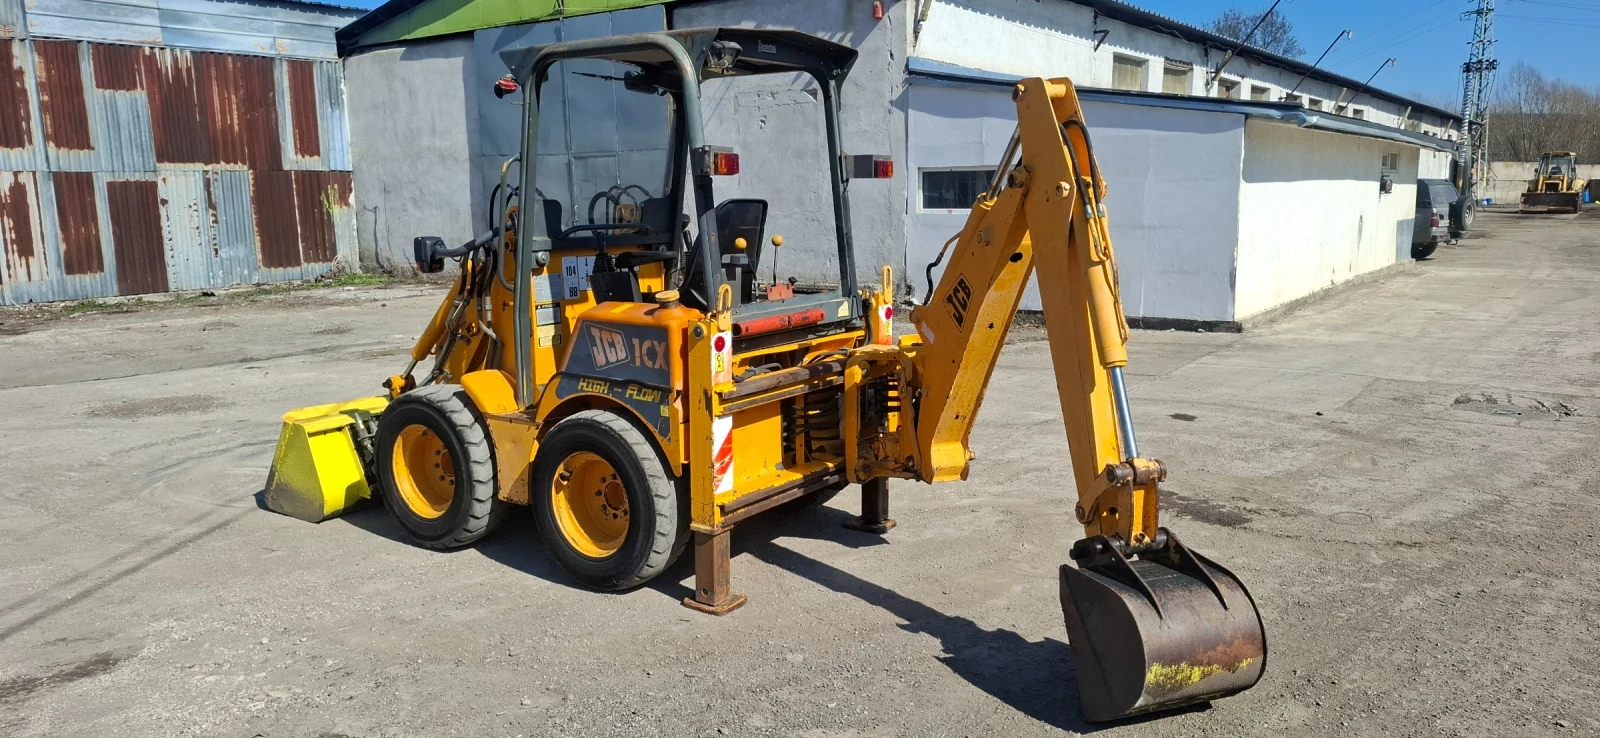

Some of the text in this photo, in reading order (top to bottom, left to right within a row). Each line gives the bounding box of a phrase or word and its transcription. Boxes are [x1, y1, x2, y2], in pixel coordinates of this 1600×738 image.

[565, 265, 576, 277] 104
[569, 286, 578, 298] 88
[946, 277, 972, 329] JCB
[589, 326, 627, 368] JCB
[631, 337, 668, 371] 1CX
[578, 378, 609, 394] HIGH
[625, 384, 662, 403] FLOW
